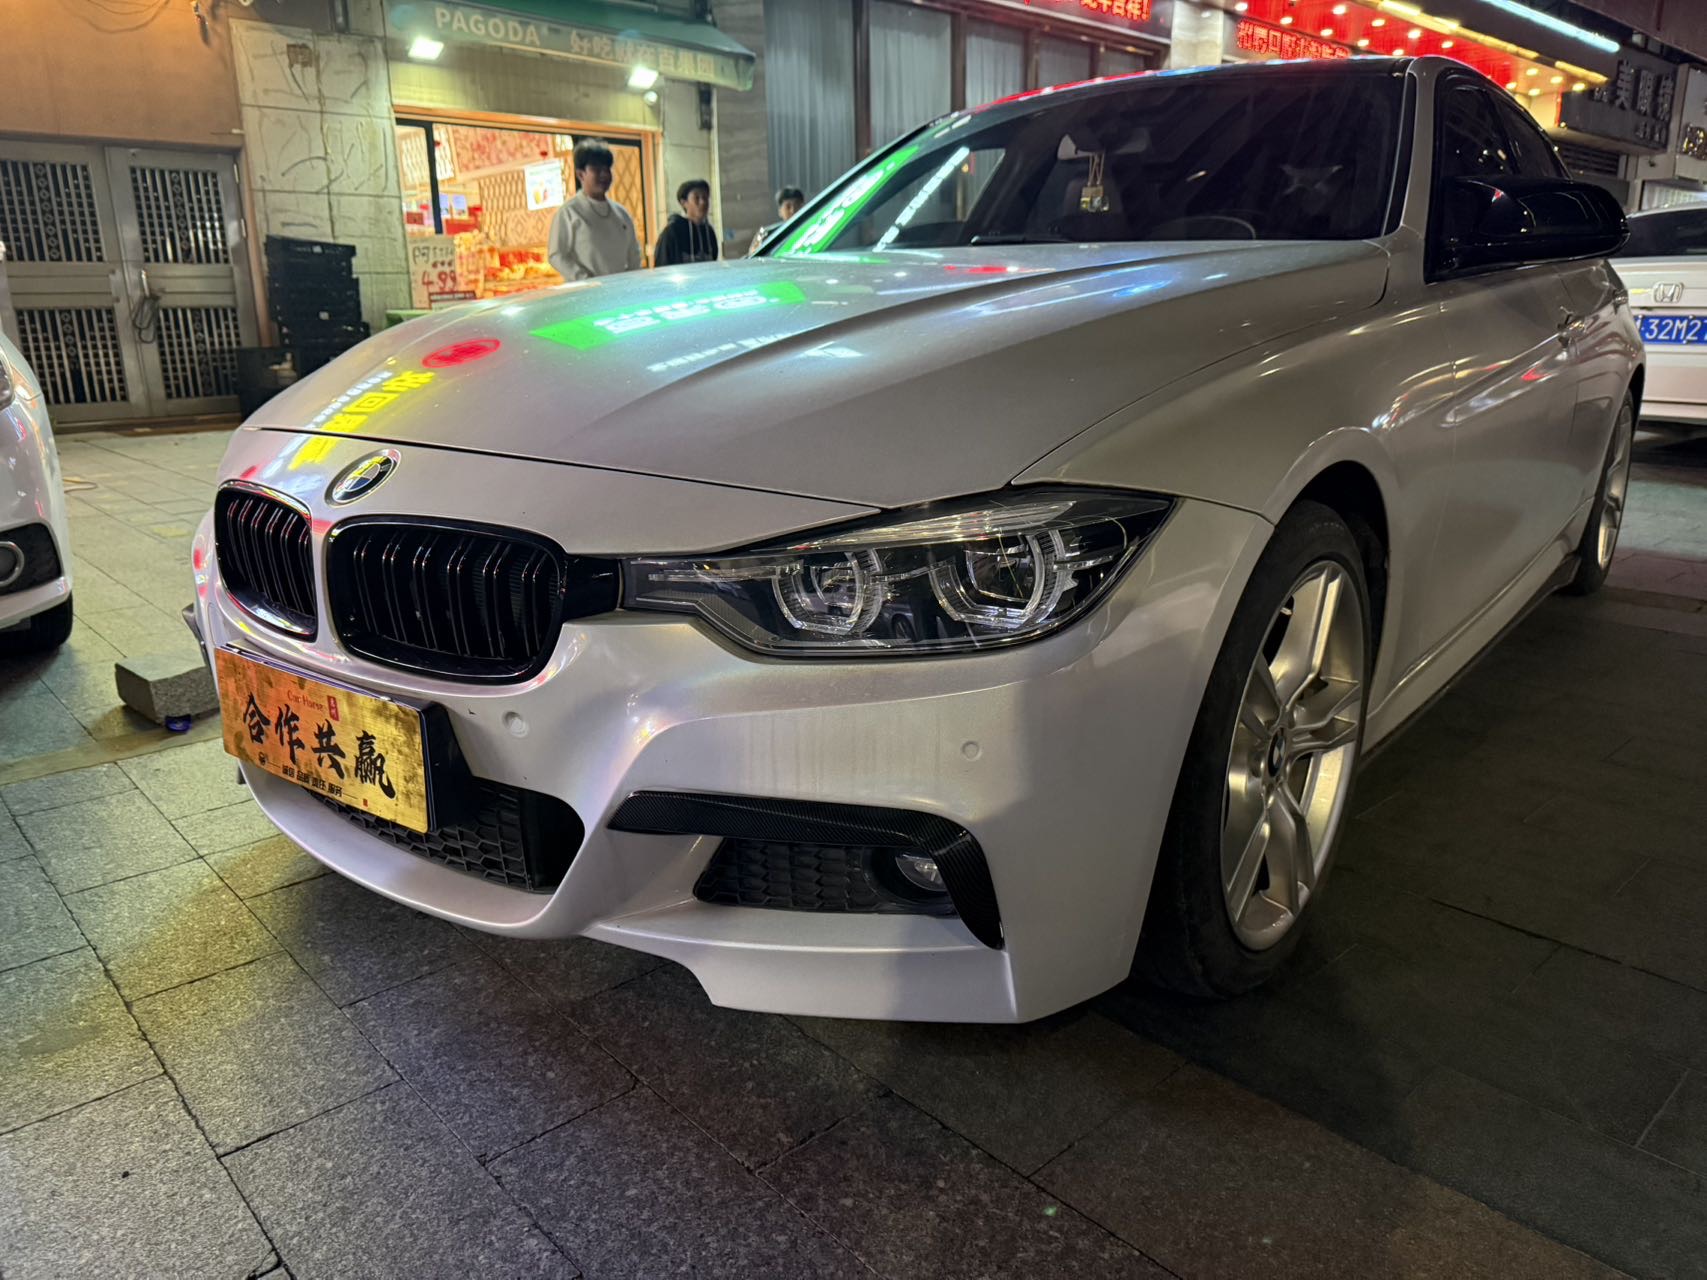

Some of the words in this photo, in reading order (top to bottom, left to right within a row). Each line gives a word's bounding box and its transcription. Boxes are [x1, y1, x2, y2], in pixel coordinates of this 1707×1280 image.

[435, 7, 541, 46] PAGODA
[243, 692, 396, 800] 合作共赢
